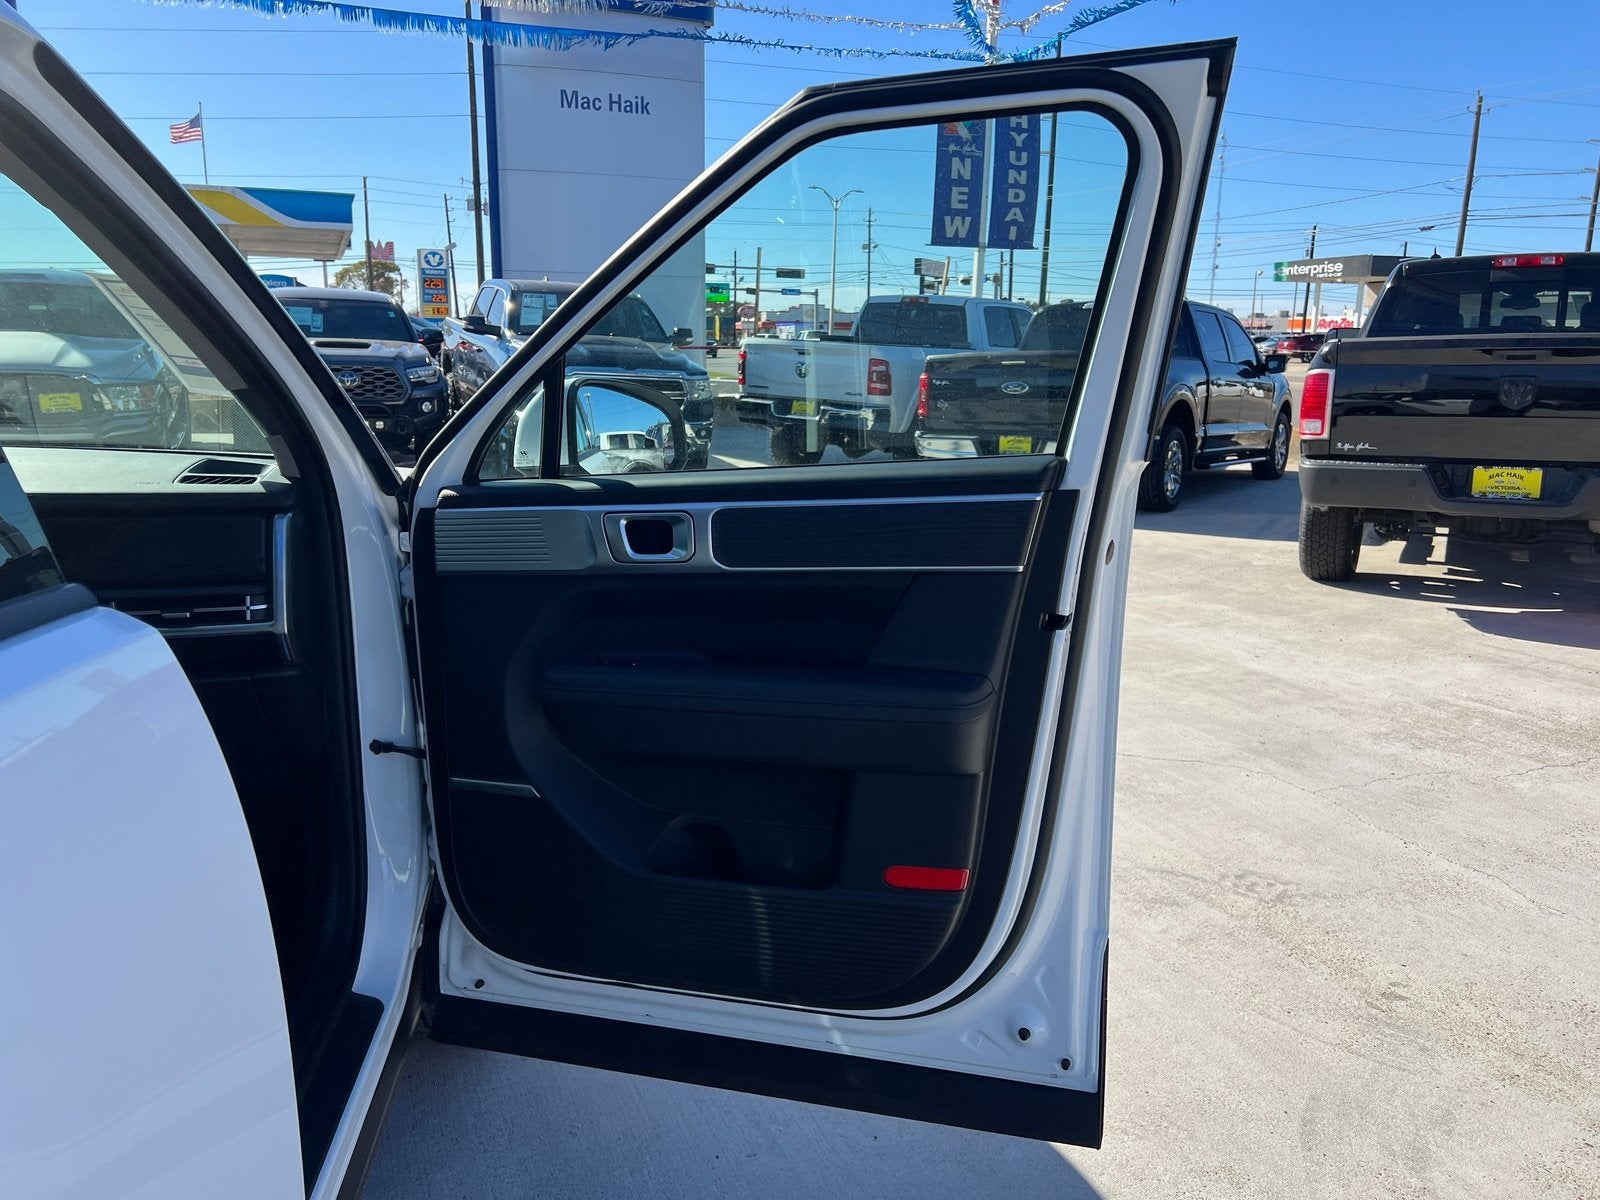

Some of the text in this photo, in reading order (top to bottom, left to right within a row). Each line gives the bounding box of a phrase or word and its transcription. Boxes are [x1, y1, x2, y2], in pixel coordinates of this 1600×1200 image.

[560, 89, 651, 115] Mac Haik
[1004, 114, 1028, 241] HYUNDAI
[943, 156, 972, 239] NEW
[1277, 261, 1343, 276] enterprise
[1316, 318, 1355, 328] AutoZon
[1488, 471, 1524, 482] MAC HAIK
